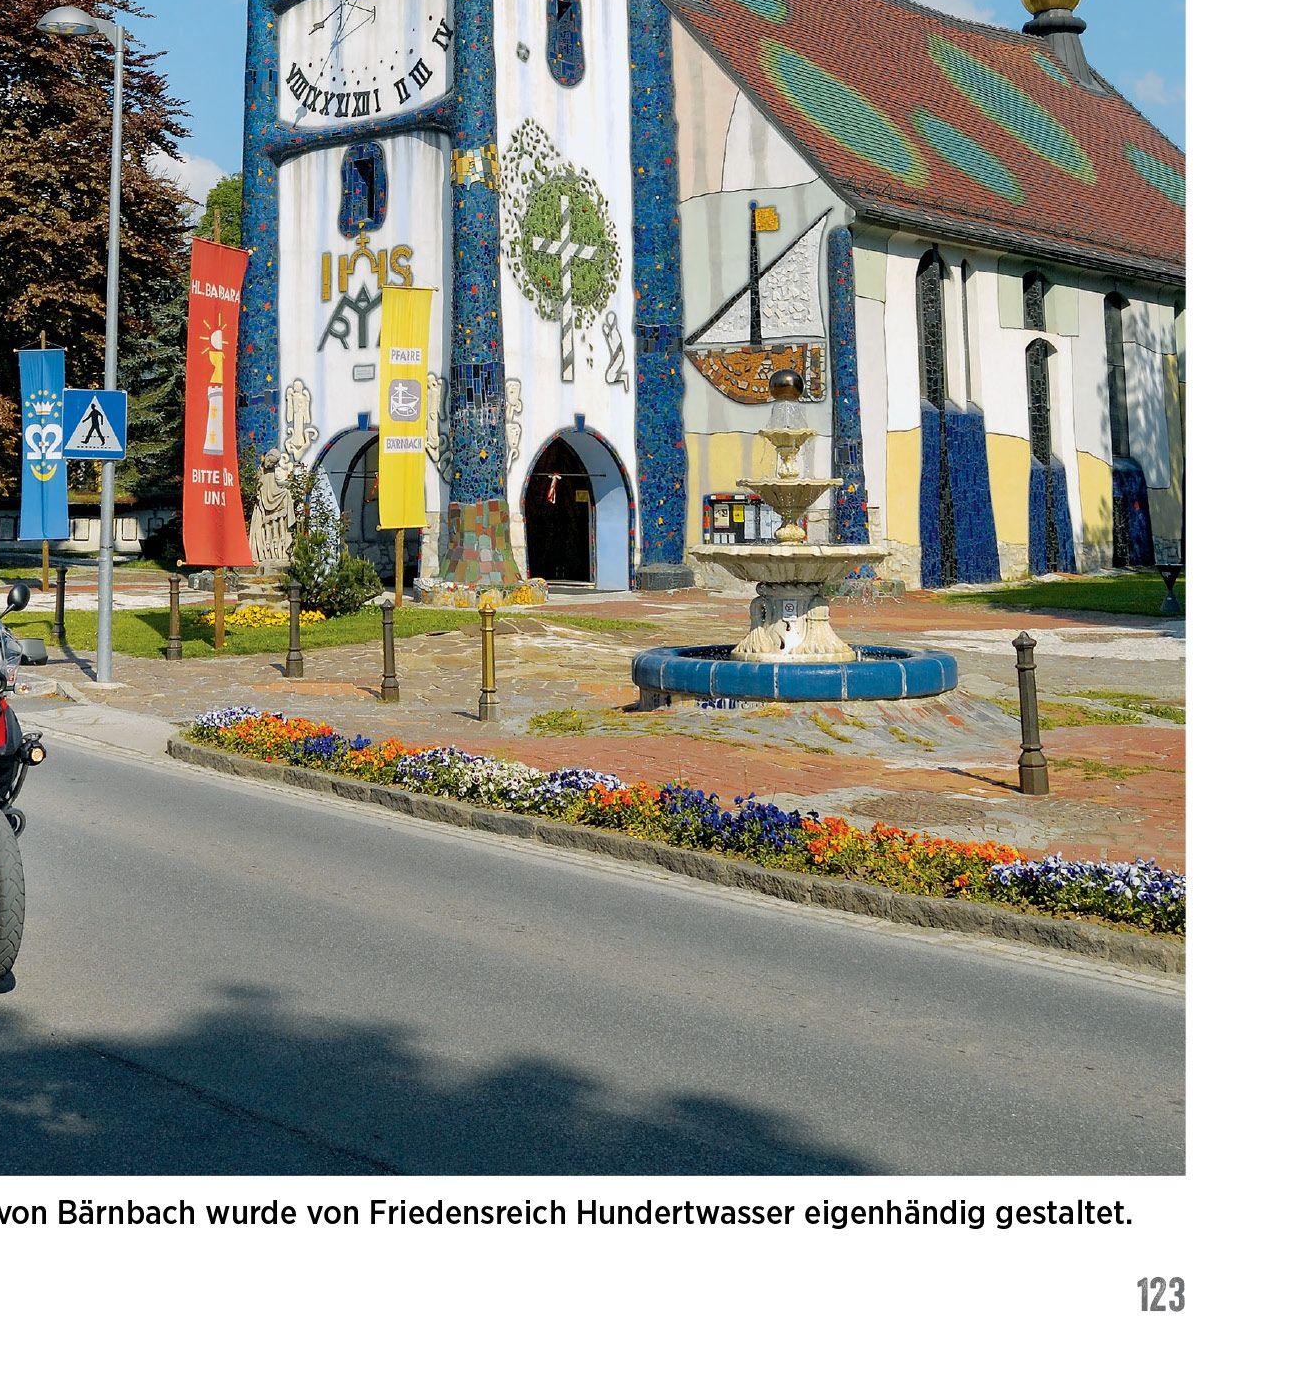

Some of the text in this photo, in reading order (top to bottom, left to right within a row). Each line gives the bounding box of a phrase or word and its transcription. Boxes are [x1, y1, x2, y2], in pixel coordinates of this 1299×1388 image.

[205, 282, 240, 304] BABARA
[192, 468, 220, 484] BITTE
[204, 490, 226, 507] UNS
[58, 1199, 195, 1225] Bärnbach
[205, 1199, 297, 1225] wurde
[306, 1205, 359, 1225] von
[370, 1199, 566, 1225] Friedensreich
[577, 1199, 795, 1225] Hundertwasser
[804, 1199, 985, 1230] eigenhändig
[995, 1199, 1132, 1230] gestaltet.
[1136, 1276, 1186, 1313] 123
